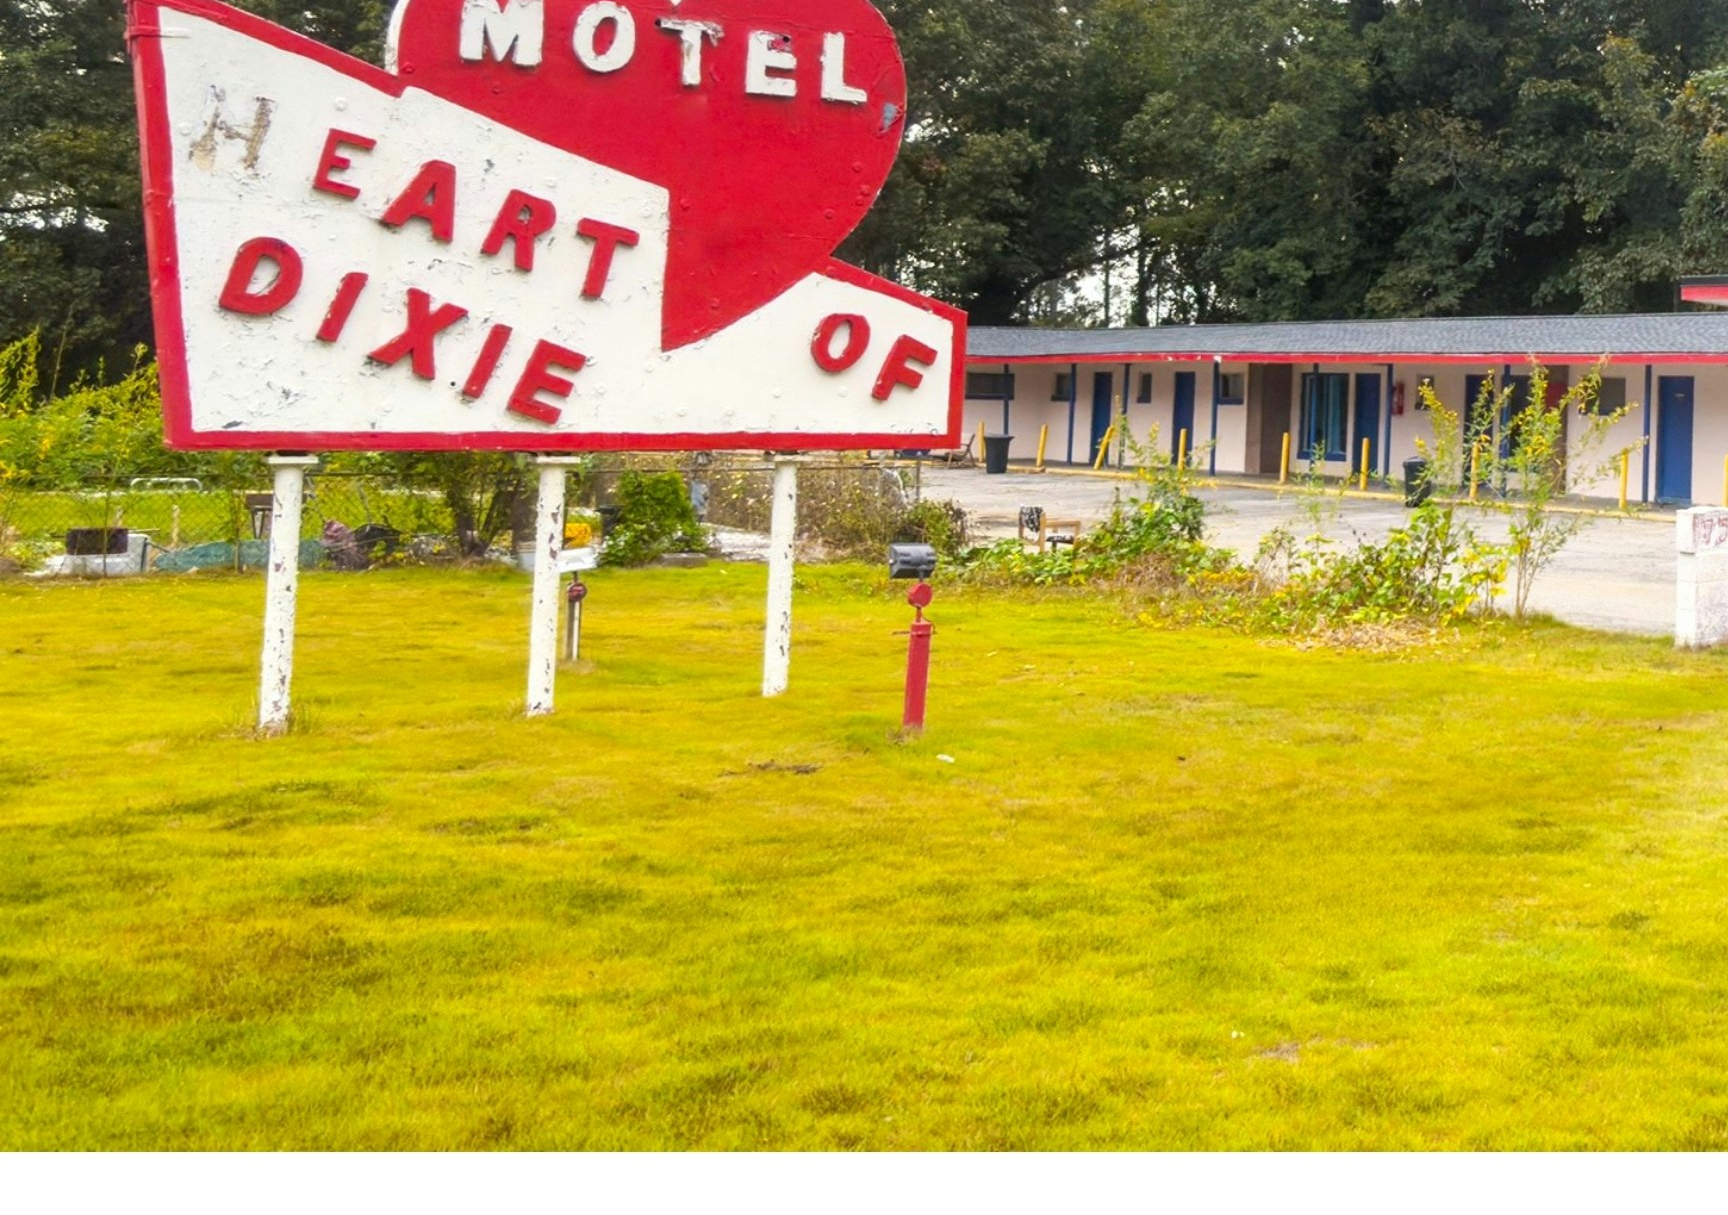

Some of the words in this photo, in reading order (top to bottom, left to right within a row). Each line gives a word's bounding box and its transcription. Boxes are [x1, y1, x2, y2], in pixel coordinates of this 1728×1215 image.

[189, 85, 640, 299] HEART
[219, 236, 587, 425] DIXIE
[810, 311, 938, 401] OF
